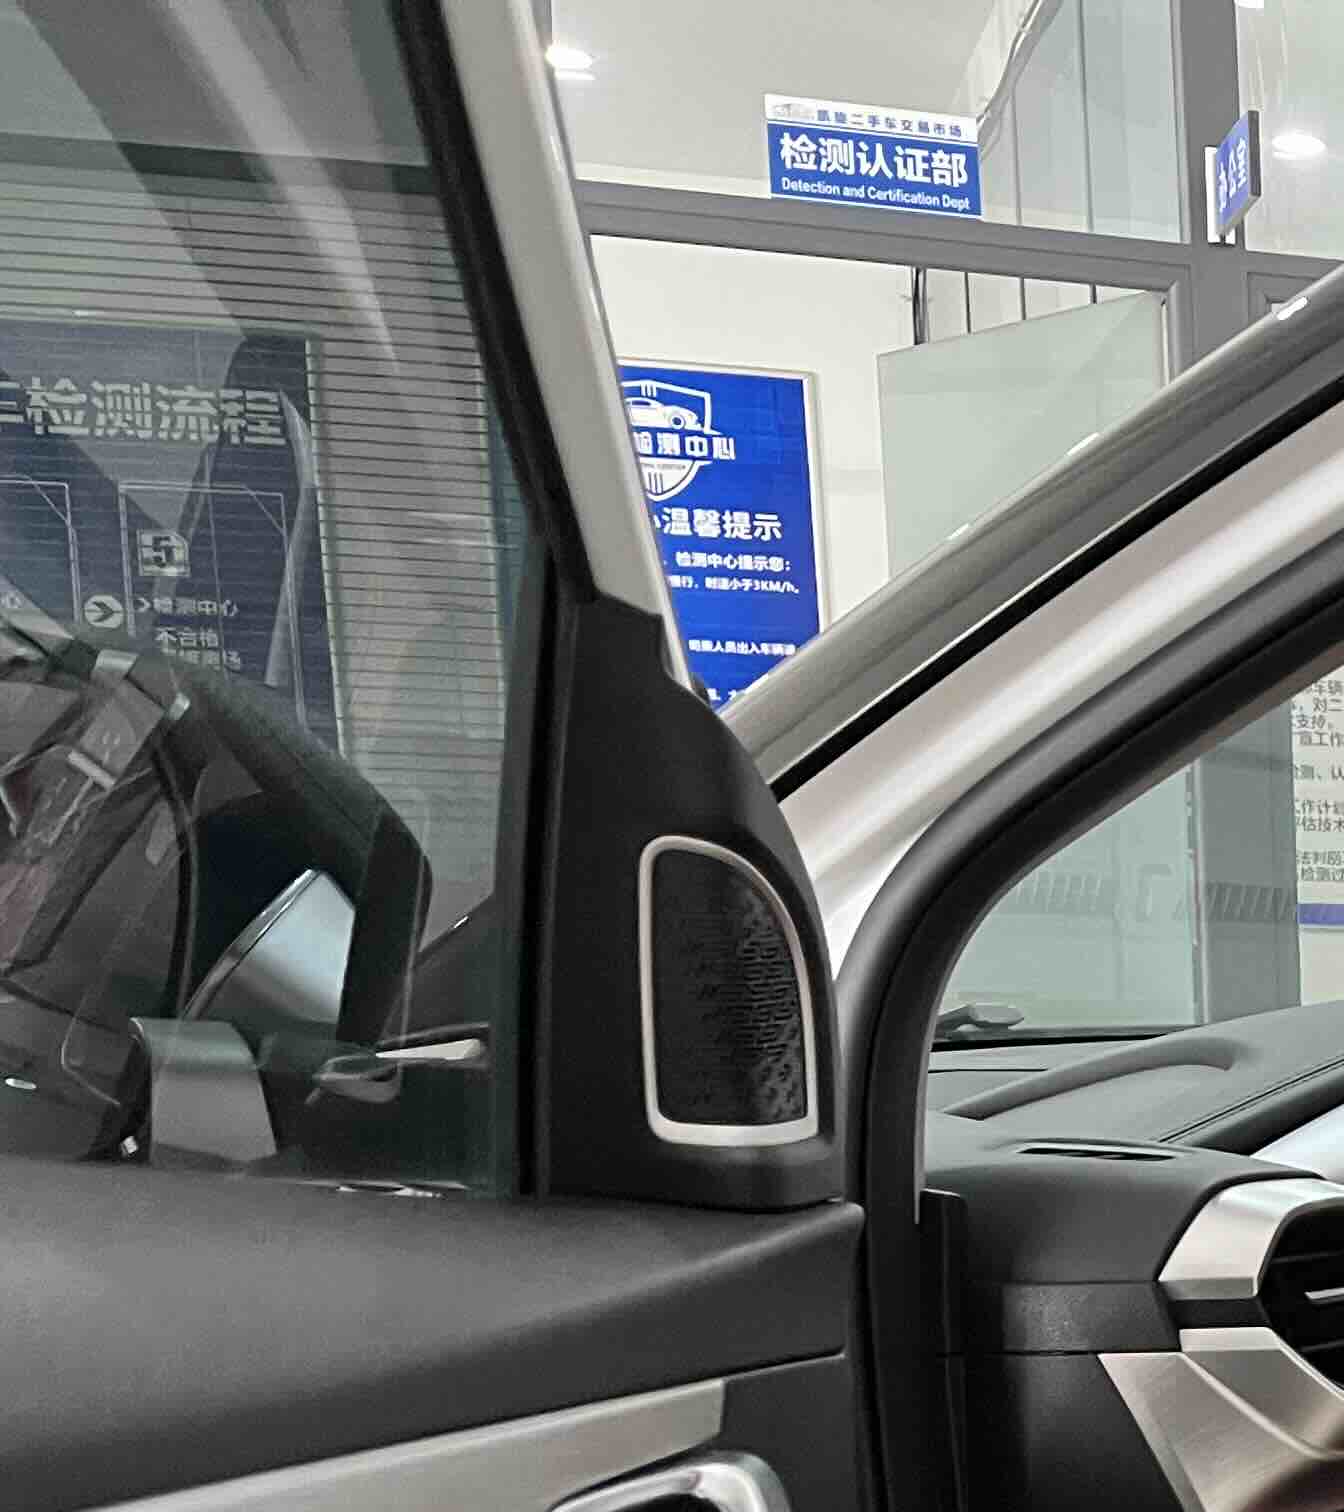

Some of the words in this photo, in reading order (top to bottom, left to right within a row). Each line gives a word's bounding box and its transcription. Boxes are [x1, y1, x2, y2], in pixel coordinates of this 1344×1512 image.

[779, 132, 968, 188] 检测认证部
[781, 176, 841, 197] Detection
[842, 184, 865, 199] and
[866, 186, 941, 208] Certification
[941, 194, 971, 211] Dept
[654, 506, 783, 541] 温馨提示
[1292, 714, 1334, 730] 支持。
